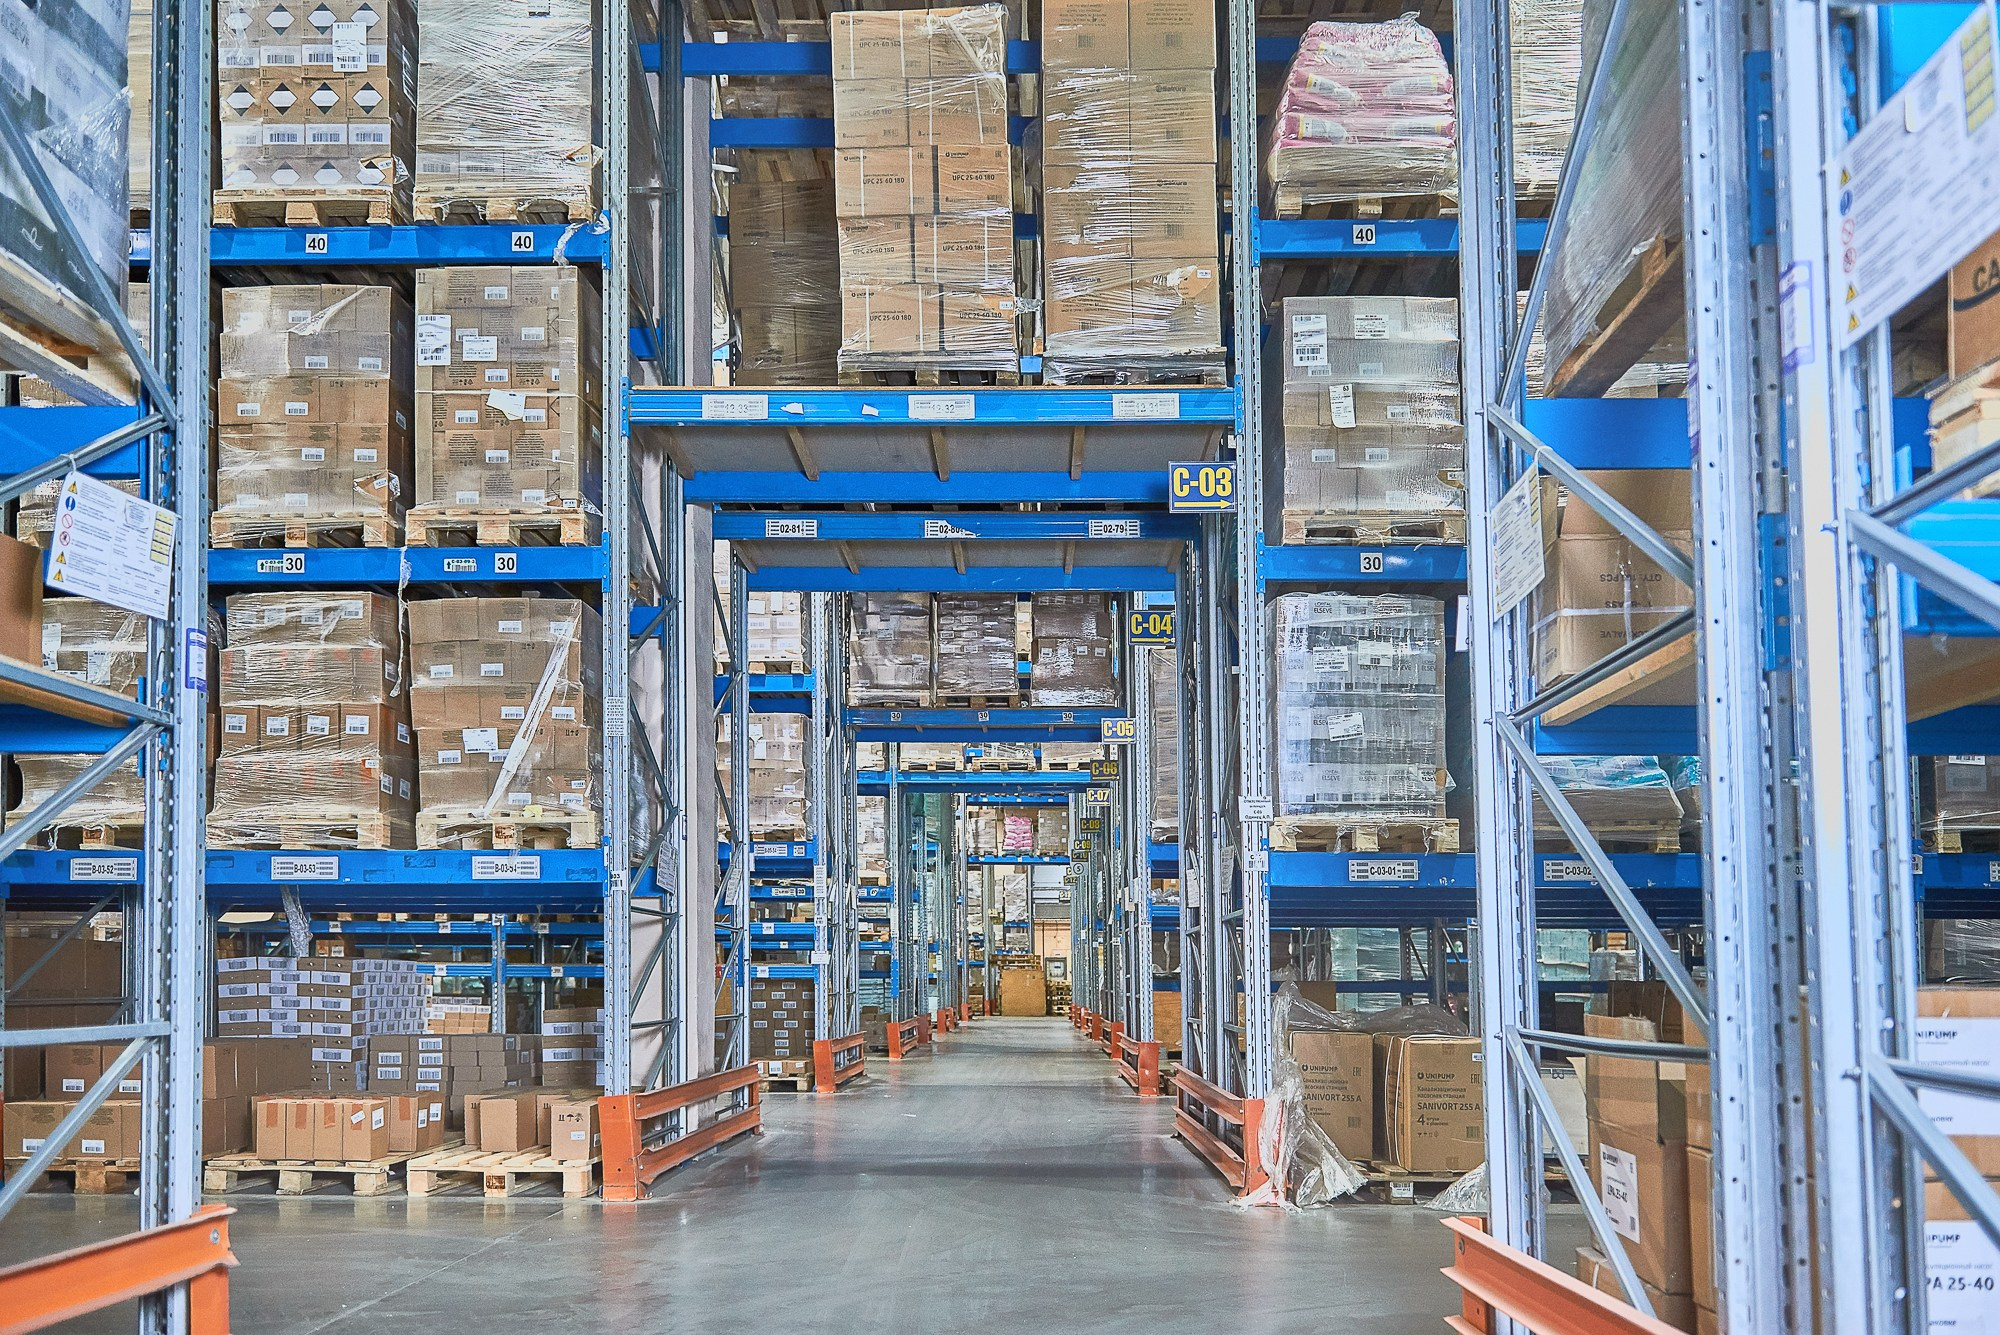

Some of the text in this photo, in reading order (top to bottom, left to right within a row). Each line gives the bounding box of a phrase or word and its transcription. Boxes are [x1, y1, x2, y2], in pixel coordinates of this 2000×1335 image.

[1356, 228, 1374, 242] 40
[308, 237, 326, 250] 40
[514, 236, 532, 249] 40
[1173, 467, 1233, 498] C-03
[780, 524, 801, 534] 02-81
[1103, 526, 1125, 534] 02-79
[286, 557, 303, 570] 30
[497, 558, 516, 570] 30
[1363, 556, 1381, 570] 30
[1600, 574, 1618, 582] PCS
[1131, 614, 1172, 634] C-04
[1103, 720, 1134, 736] C-05
[1091, 762, 1118, 774] C-06
[1088, 790, 1110, 800] C-07
[1081, 820, 1100, 828] C-08
[1074, 840, 1091, 850] C-09
[92, 865, 114, 874] B-03-52
[294, 864, 316, 874] B-03-53
[1370, 866, 1396, 876] C-03-01
[1564, 867, 1592, 876] C-03-02
[1916, 1031, 1958, 1040] NIPUMP
[1417, 1102, 1458, 1110] SANIVORT
[1416, 1114, 1426, 1126] 4
[1948, 1277, 1994, 1291] 25-40
